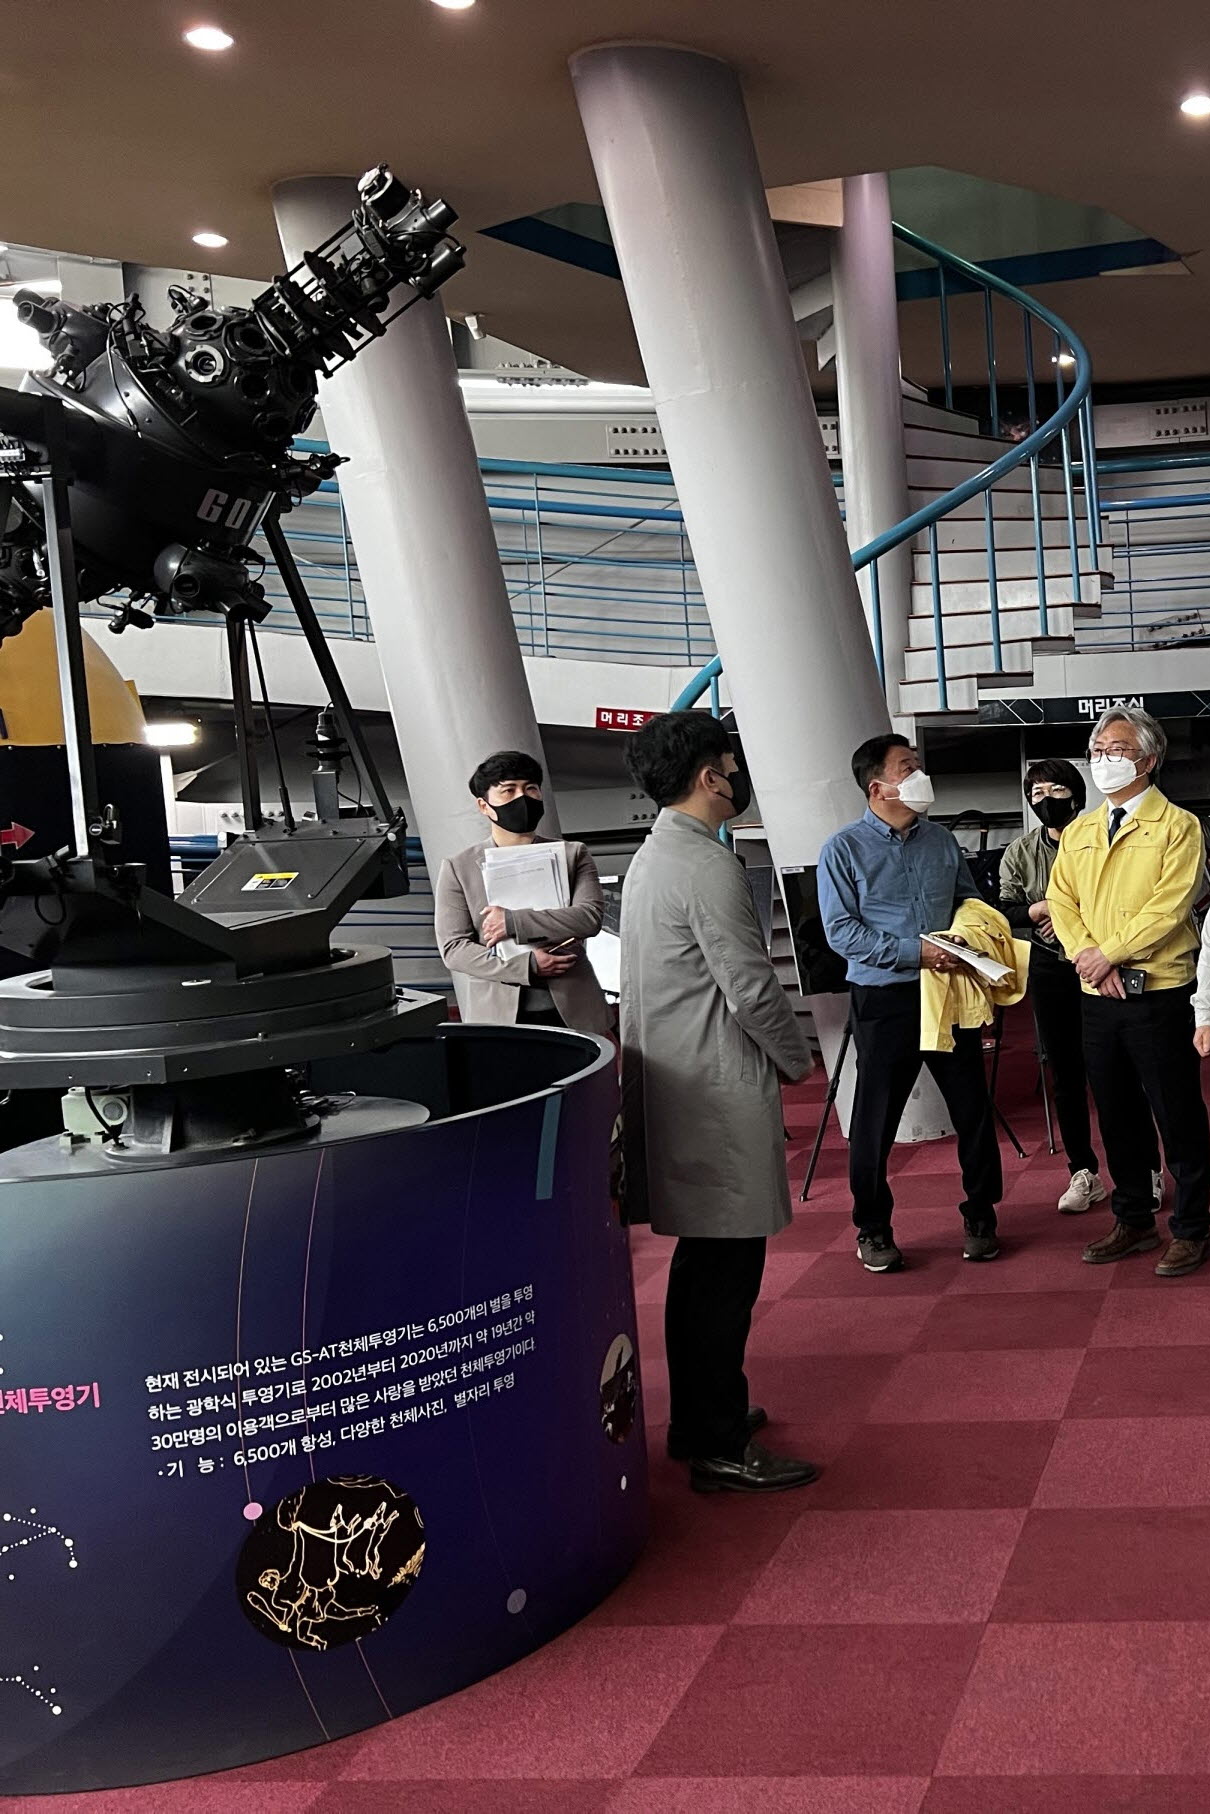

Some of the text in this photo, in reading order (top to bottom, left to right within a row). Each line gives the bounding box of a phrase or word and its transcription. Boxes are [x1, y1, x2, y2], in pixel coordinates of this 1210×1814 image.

[600, 711, 644, 726] 머리조
[144, 1283, 534, 1393] 현재 전시되어 있는 GS-AT천체투영기는 6,500개의 별을 투영
[147, 1309, 535, 1422] 하는 광학식 투영기로 2002년부터 2020년까지 약 19년간 약
[0, 1382, 100, 1415] 체투영기
[151, 1424, 222, 1451] 30만명의
[226, 1400, 337, 1438] 이용객으로부터
[340, 1392, 371, 1415] 많은
[373, 1379, 416, 1404] 사랑을
[418, 1366, 458, 1392] 받았던
[233, 1438, 297, 1467] 6,500개
[300, 1430, 337, 1453] 항성,
[340, 1416, 386, 1441] 다양한
[389, 1399, 448, 1429] 천체사진,
[453, 1382, 491, 1409] 별자리
[493, 1372, 516, 1394] 투영
